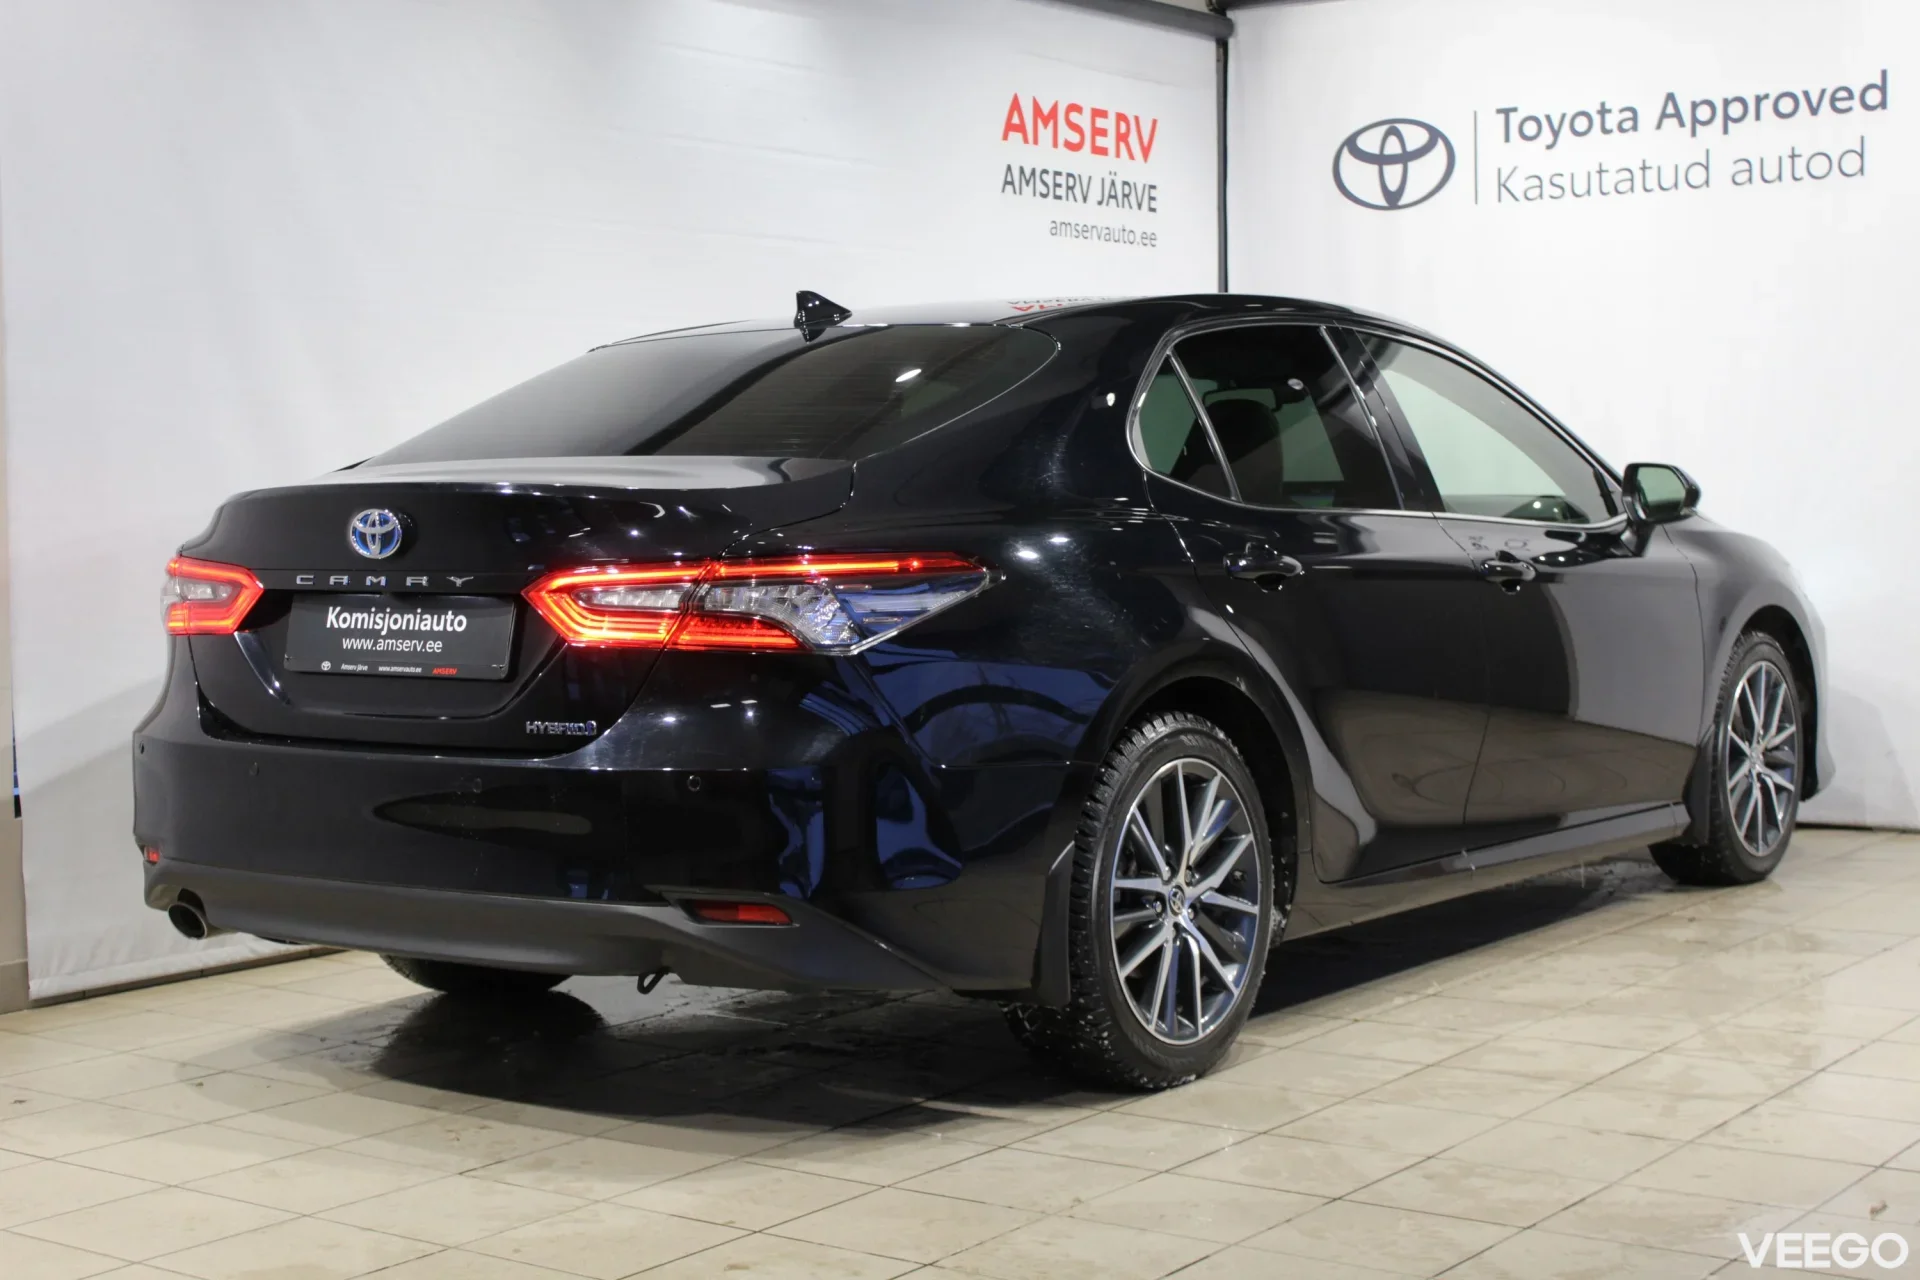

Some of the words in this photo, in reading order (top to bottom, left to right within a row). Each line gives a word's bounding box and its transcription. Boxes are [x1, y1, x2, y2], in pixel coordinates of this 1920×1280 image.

[1496, 100, 1639, 149] Toyota
[1655, 69, 1889, 137] Approved
[1001, 92, 1158, 164] AMSERV
[1496, 148, 1711, 203] Kasutatud
[1730, 135, 1867, 187] autod
[1001, 163, 1092, 204] AMSERV
[1096, 170, 1158, 214] JÄRVE
[1049, 219, 1158, 248] amservauto.ee
[296, 575, 474, 587] CAMRY
[326, 606, 467, 636] Komisjoniauto
[342, 637, 443, 653] www.amserv.ee
[432, 667, 457, 675] AMSERV
